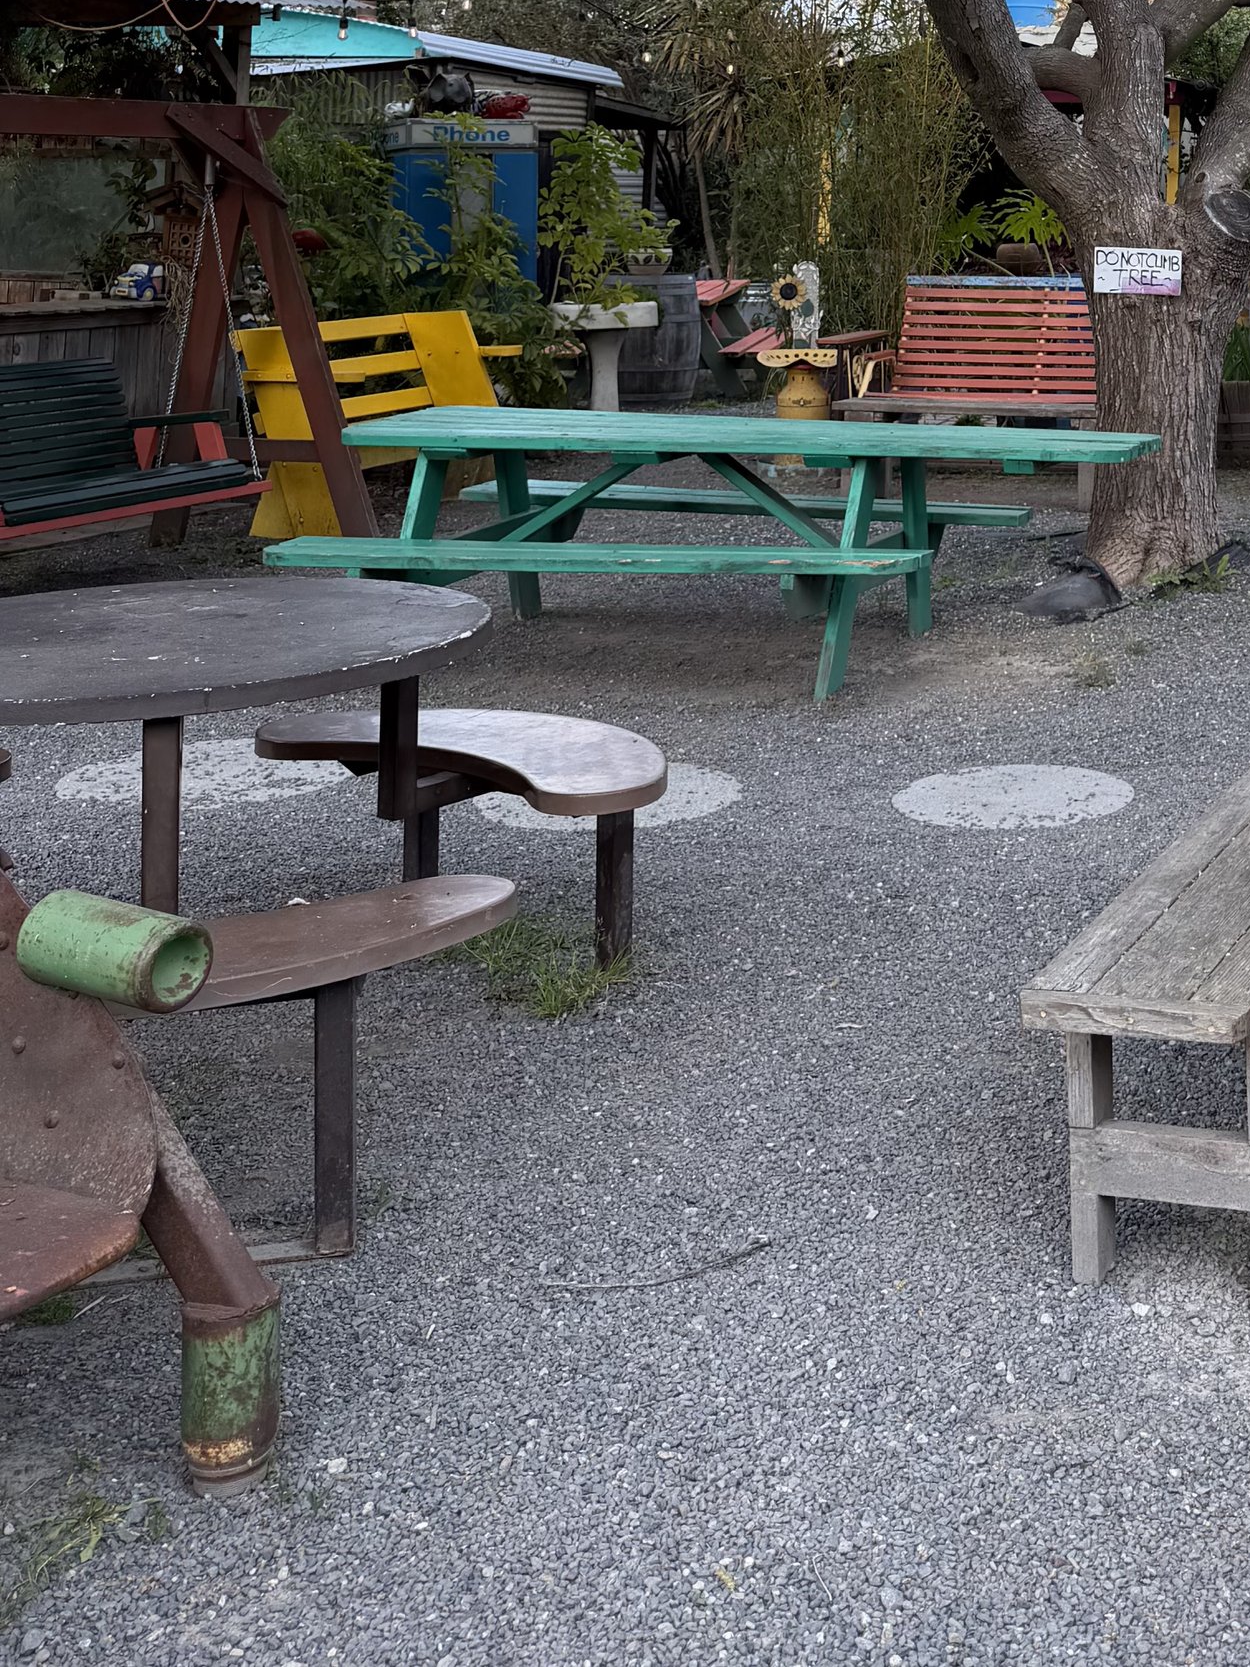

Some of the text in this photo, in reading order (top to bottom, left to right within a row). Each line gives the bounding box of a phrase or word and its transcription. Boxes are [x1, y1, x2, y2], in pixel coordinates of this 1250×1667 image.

[433, 125, 510, 142] Phone
[1096, 249, 1181, 272] DO NOT CLIMB
[1112, 268, 1164, 287] TREE
